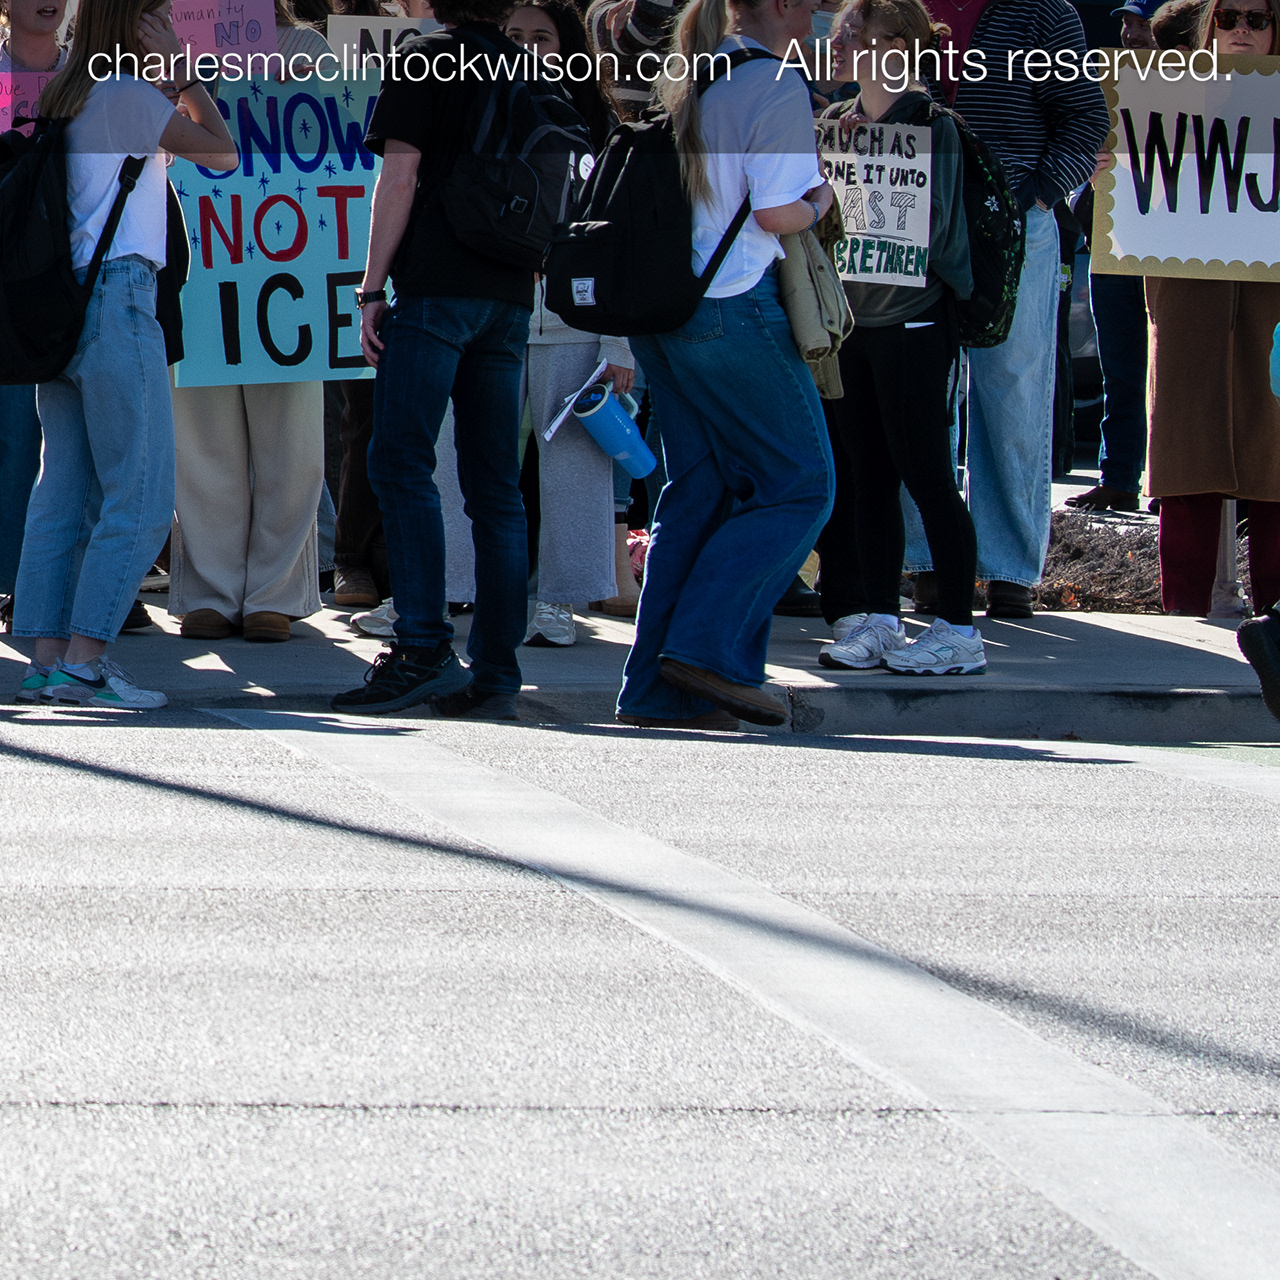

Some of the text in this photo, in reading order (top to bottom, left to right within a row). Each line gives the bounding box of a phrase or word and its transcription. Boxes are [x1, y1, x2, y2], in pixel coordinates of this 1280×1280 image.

[214, 19, 262, 48] NO
[890, 131, 917, 159] AS
[1120, 108, 1280, 215] WWJ
[863, 163, 886, 184] IT
[890, 167, 927, 188] UNTO
[198, 185, 366, 270] NOT
[842, 186, 917, 231] AST
[835, 237, 929, 278] BRETHREN
[218, 272, 377, 370] ICE
